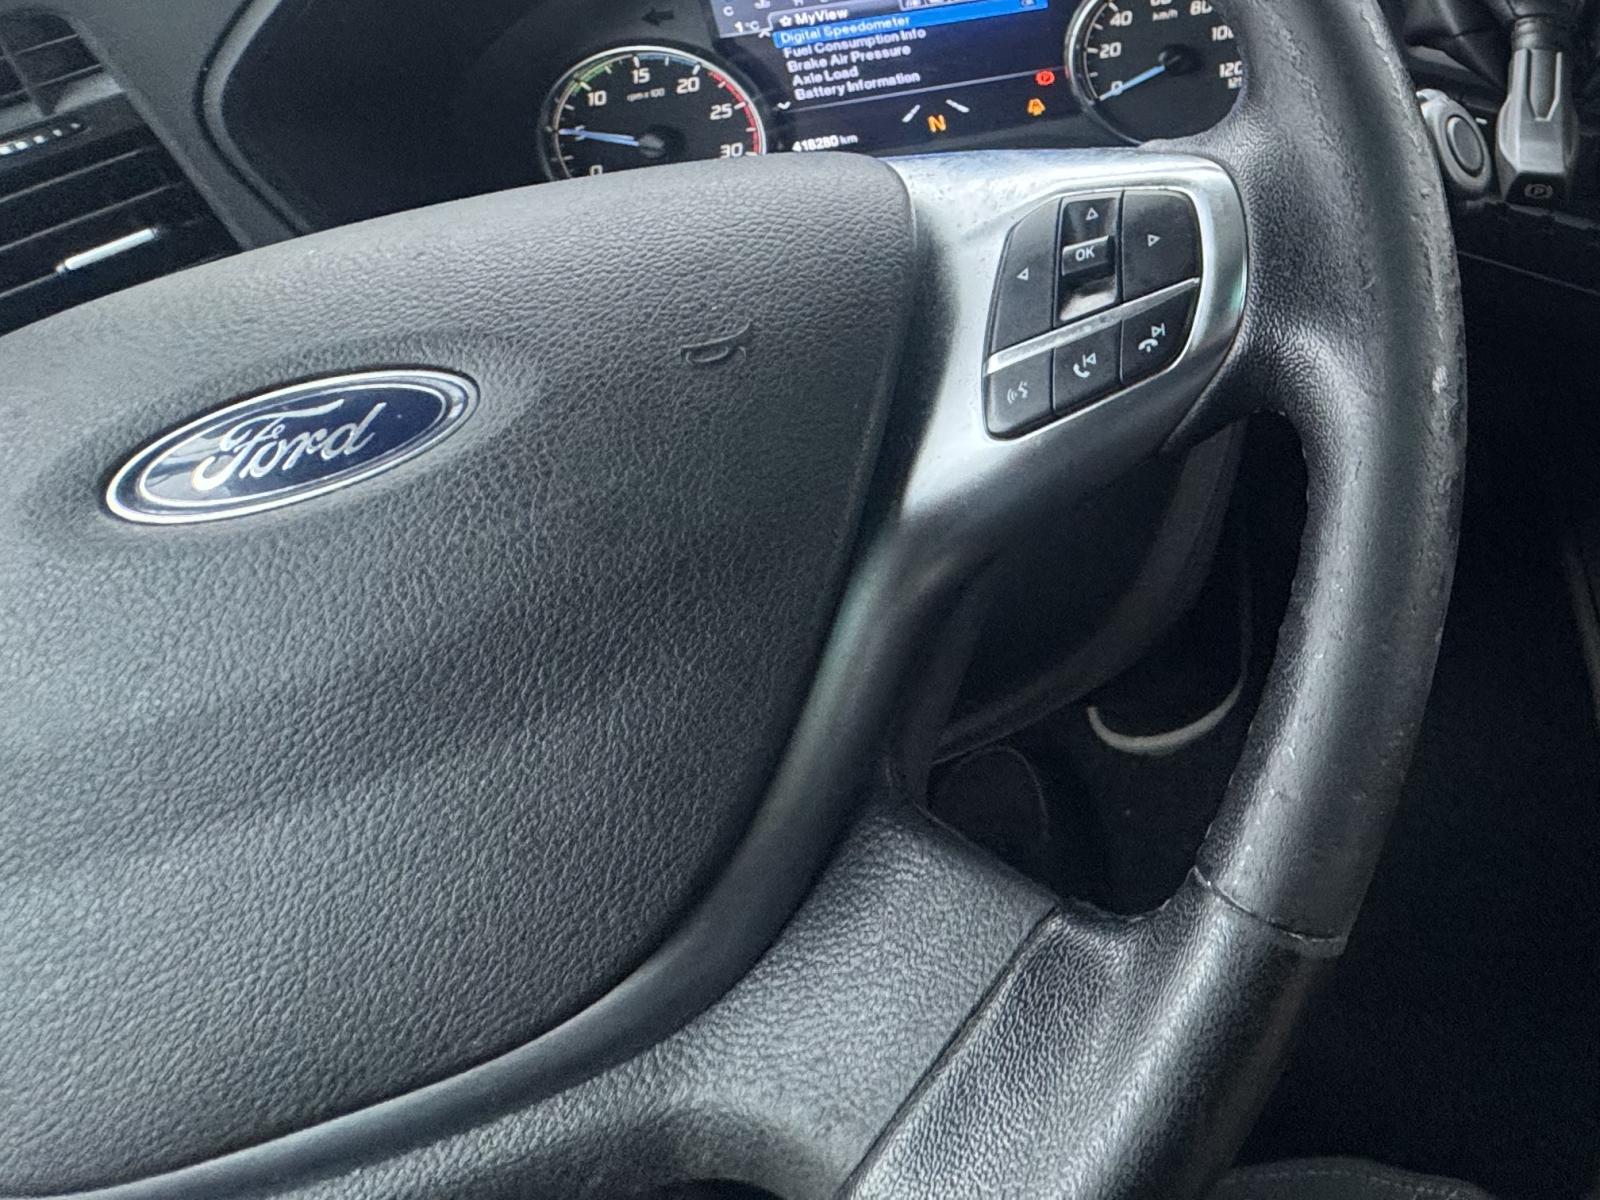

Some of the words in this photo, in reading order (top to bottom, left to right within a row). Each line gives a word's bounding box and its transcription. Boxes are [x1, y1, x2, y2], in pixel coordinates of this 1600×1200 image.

[794, 8, 849, 26] MyView
[1110, 10, 1133, 27] 40
[1152, 8, 1178, 22] km/h
[780, 27, 821, 45] Digital
[823, 16, 911, 39] Speedometer
[783, 43, 813, 59] Fuel
[814, 30, 900, 54] Consumption
[901, 27, 927, 41] Info
[1099, 42, 1122, 59] 20
[786, 56, 828, 73] Brake
[830, 53, 849, 67] Air
[851, 44, 912, 64] Pressure
[631, 67, 650, 84] 15
[792, 70, 823, 87] Axle
[824, 65, 859, 81] Load
[676, 77, 700, 94] 20
[794, 82, 846, 101] Battery
[846, 72, 921, 93] Information
[587, 90, 607, 106] 10
[709, 103, 733, 120] 25
[927, 114, 947, 133] N
[839, 134, 858, 145] km
[720, 142, 744, 159] 30
[1075, 245, 1096, 262] OK
[191, 398, 388, 492] Ford
